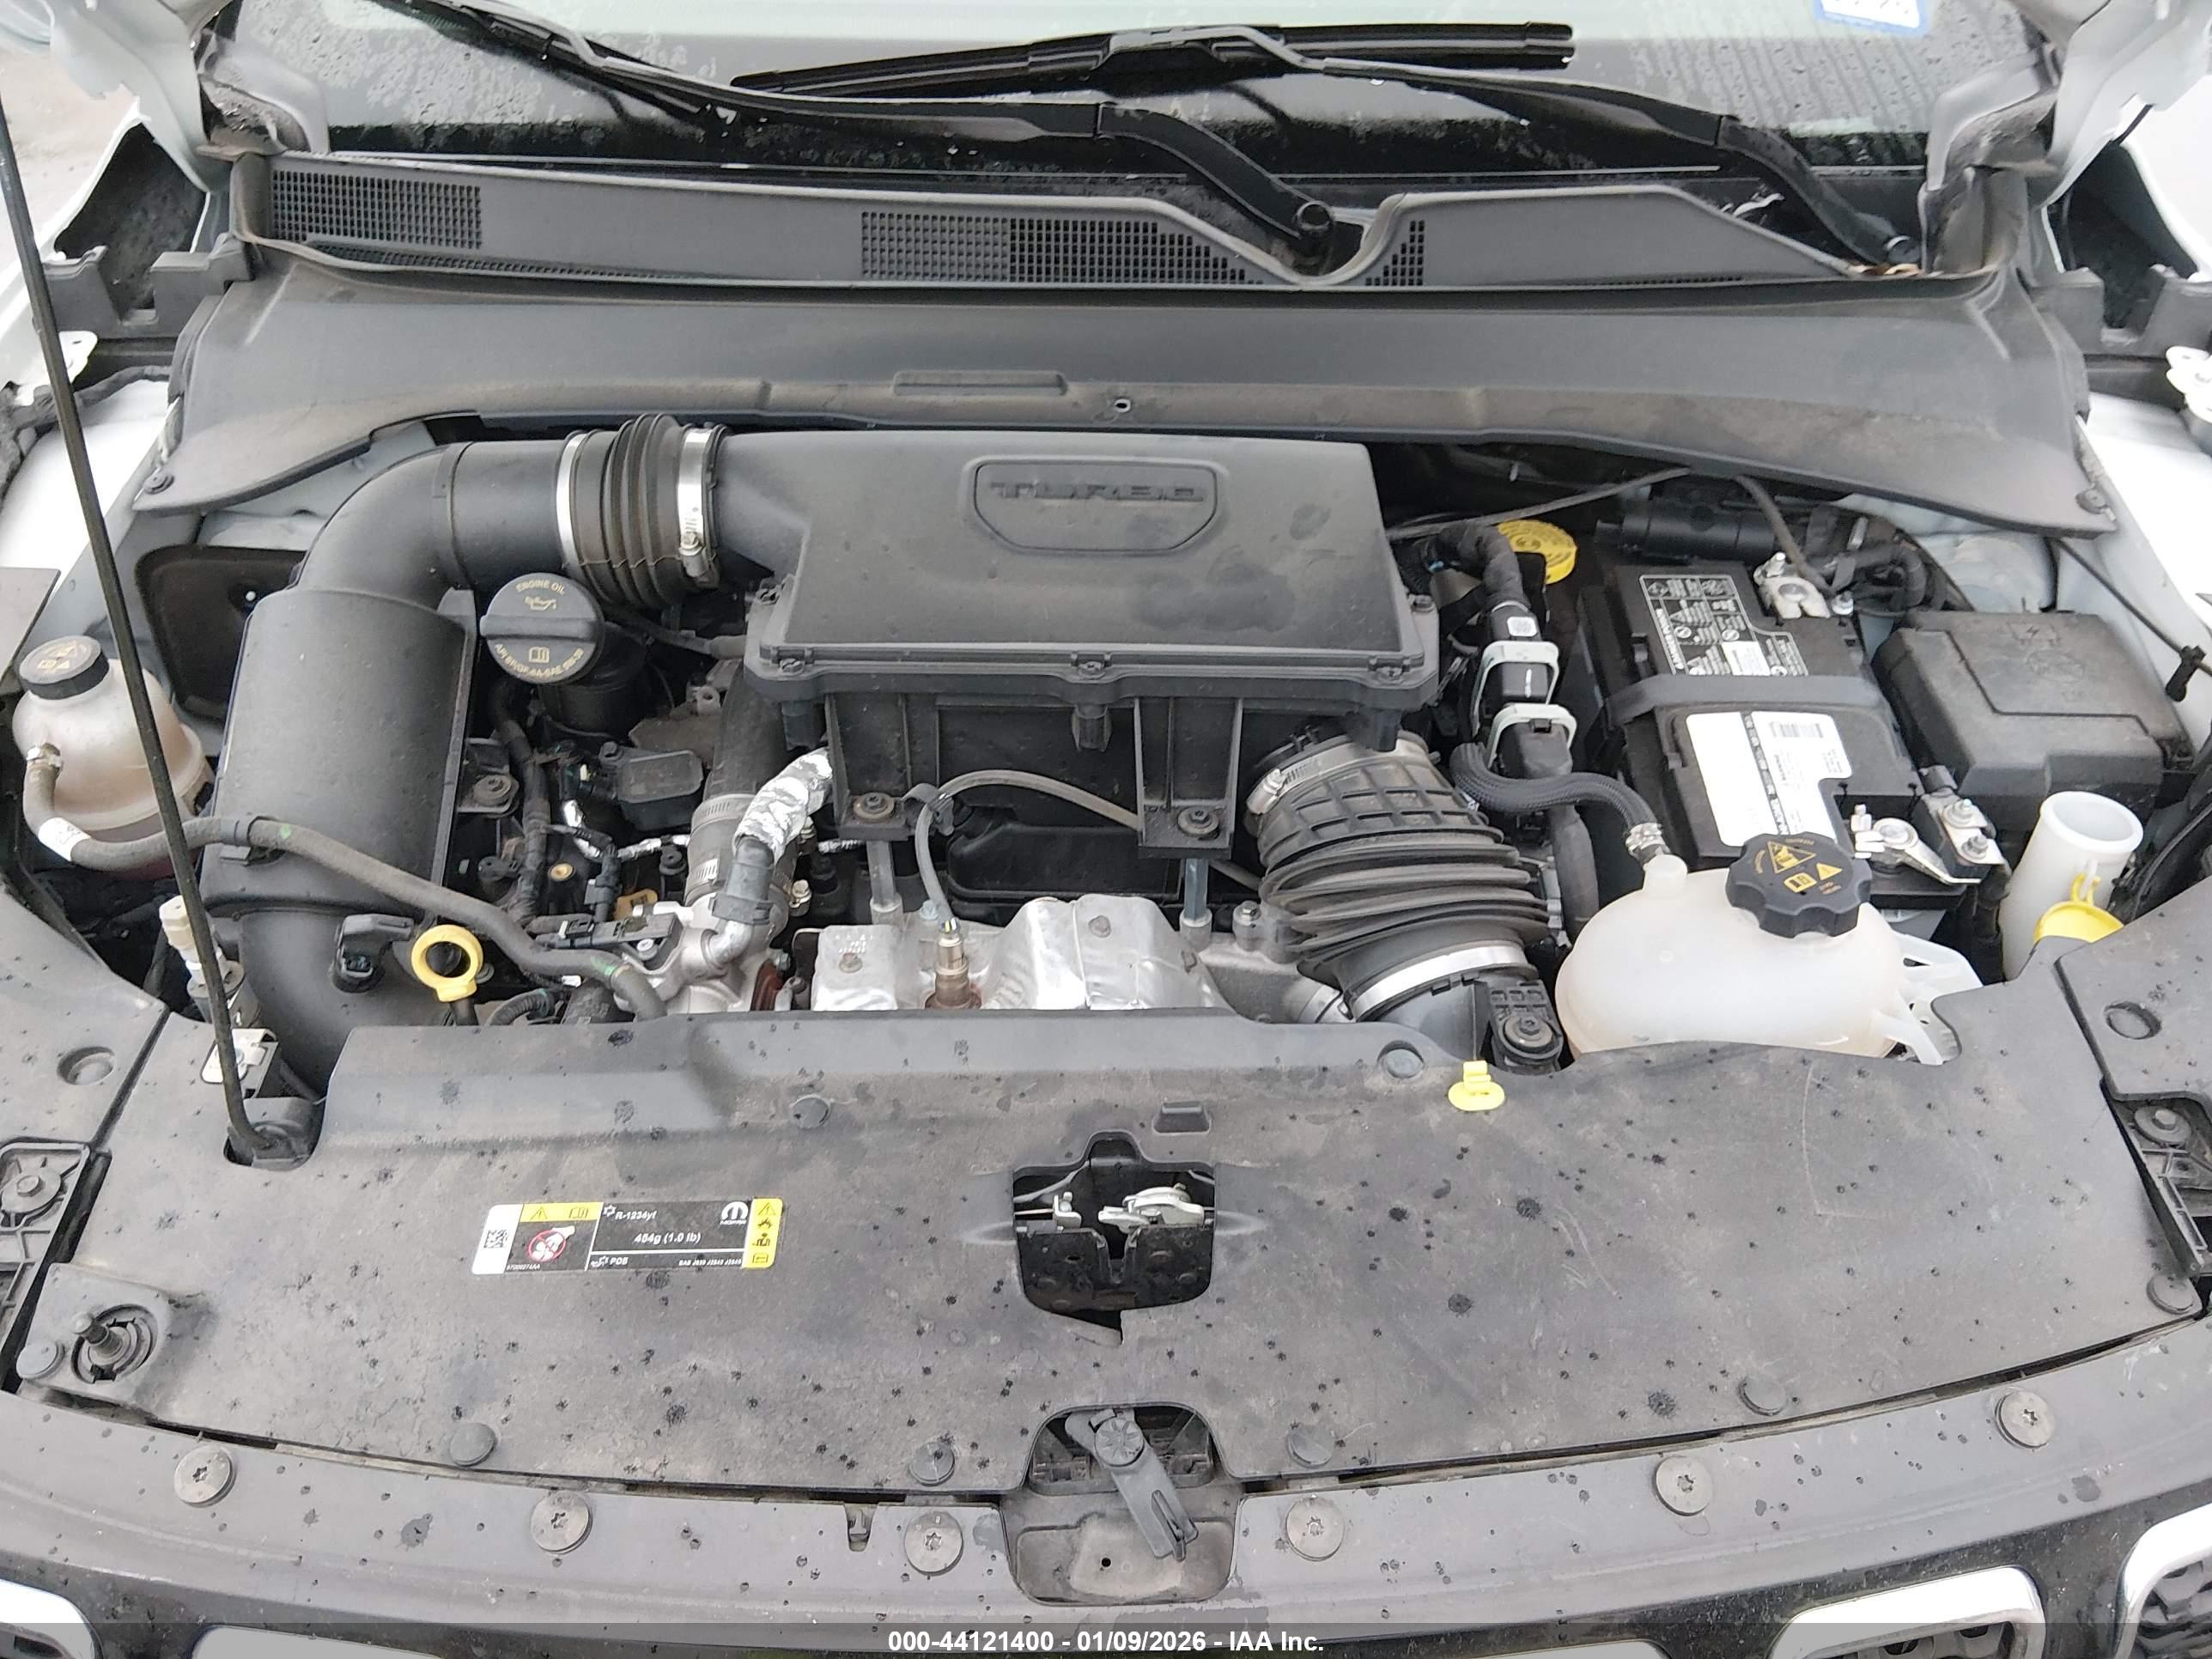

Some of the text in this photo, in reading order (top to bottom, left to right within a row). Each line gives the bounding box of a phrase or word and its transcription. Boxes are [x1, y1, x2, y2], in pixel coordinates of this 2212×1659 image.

[515, 579, 565, 595] ENGINE OIL
[615, 1210, 658, 1222] R-1234yf
[634, 1232, 662, 1245] 454g
